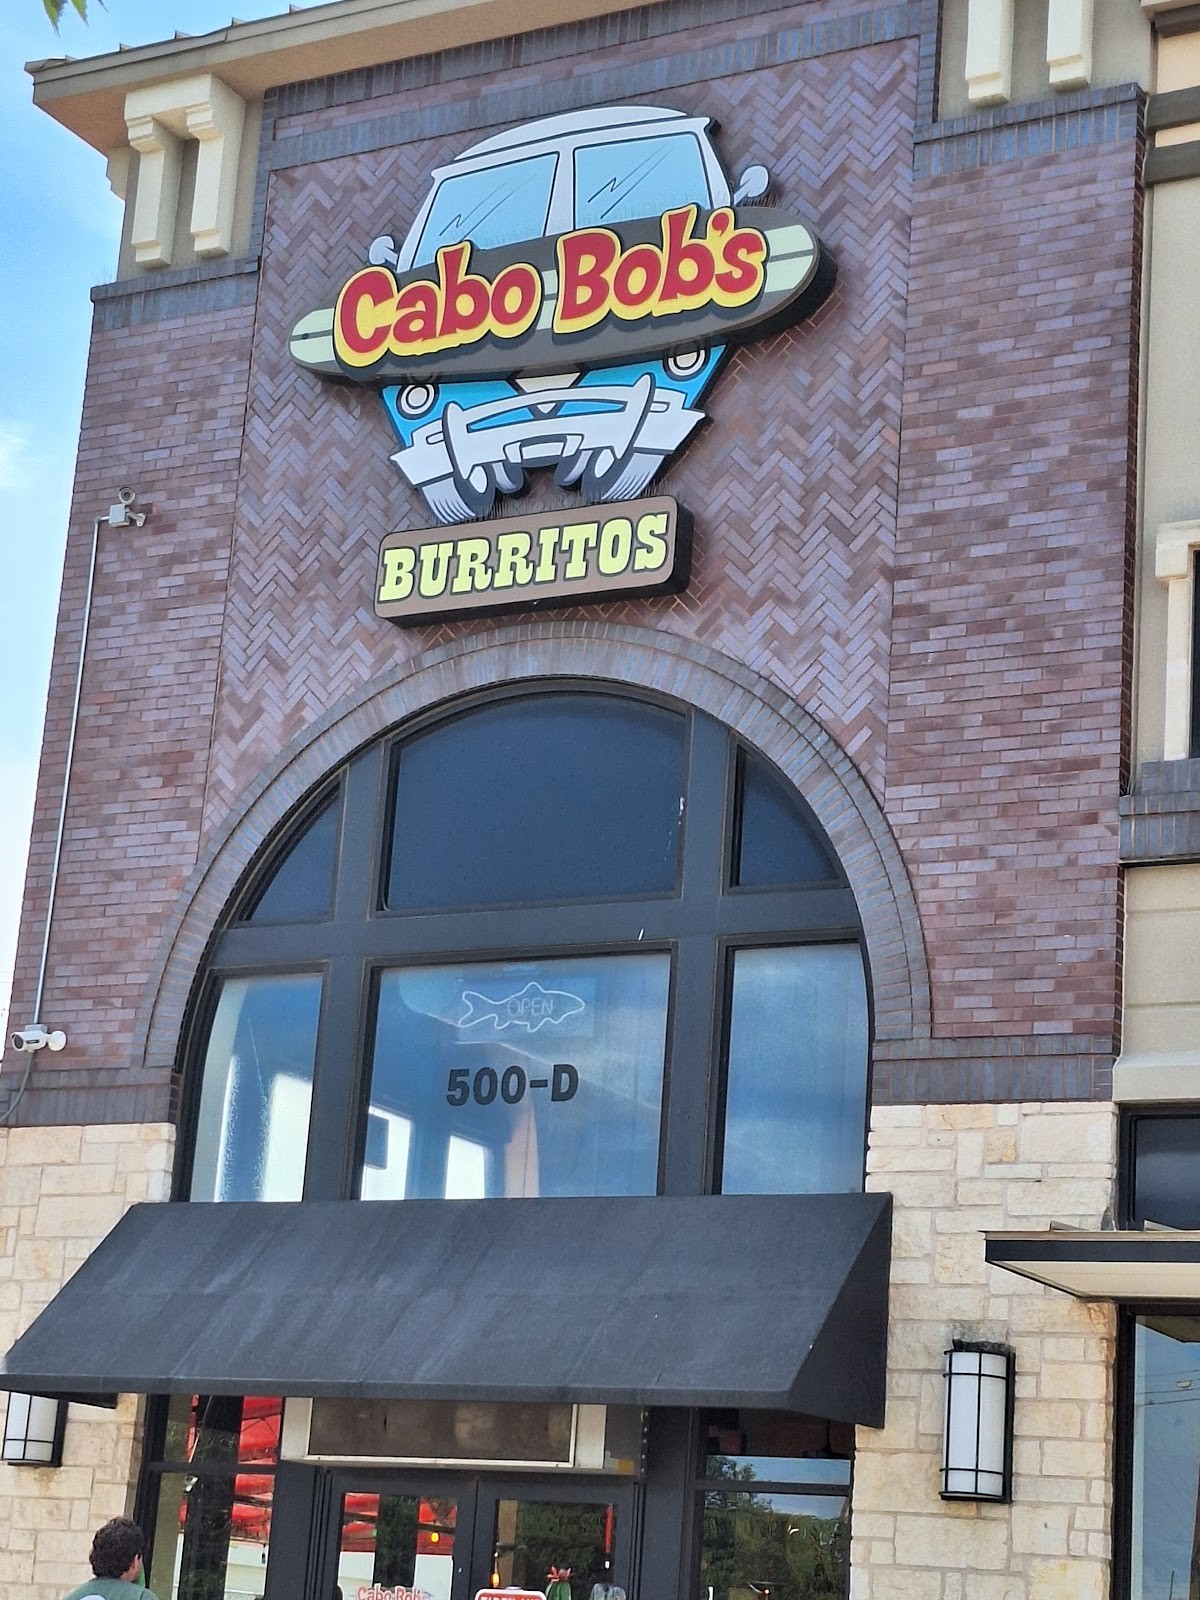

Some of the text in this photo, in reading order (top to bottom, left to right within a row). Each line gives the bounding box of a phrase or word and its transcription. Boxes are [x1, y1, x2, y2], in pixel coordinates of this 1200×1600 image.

[336, 206, 767, 361] Cabo Bob's
[377, 512, 669, 602] BURRITOS
[507, 997, 554, 1017] OPEN
[446, 1063, 579, 1106] 500-D
